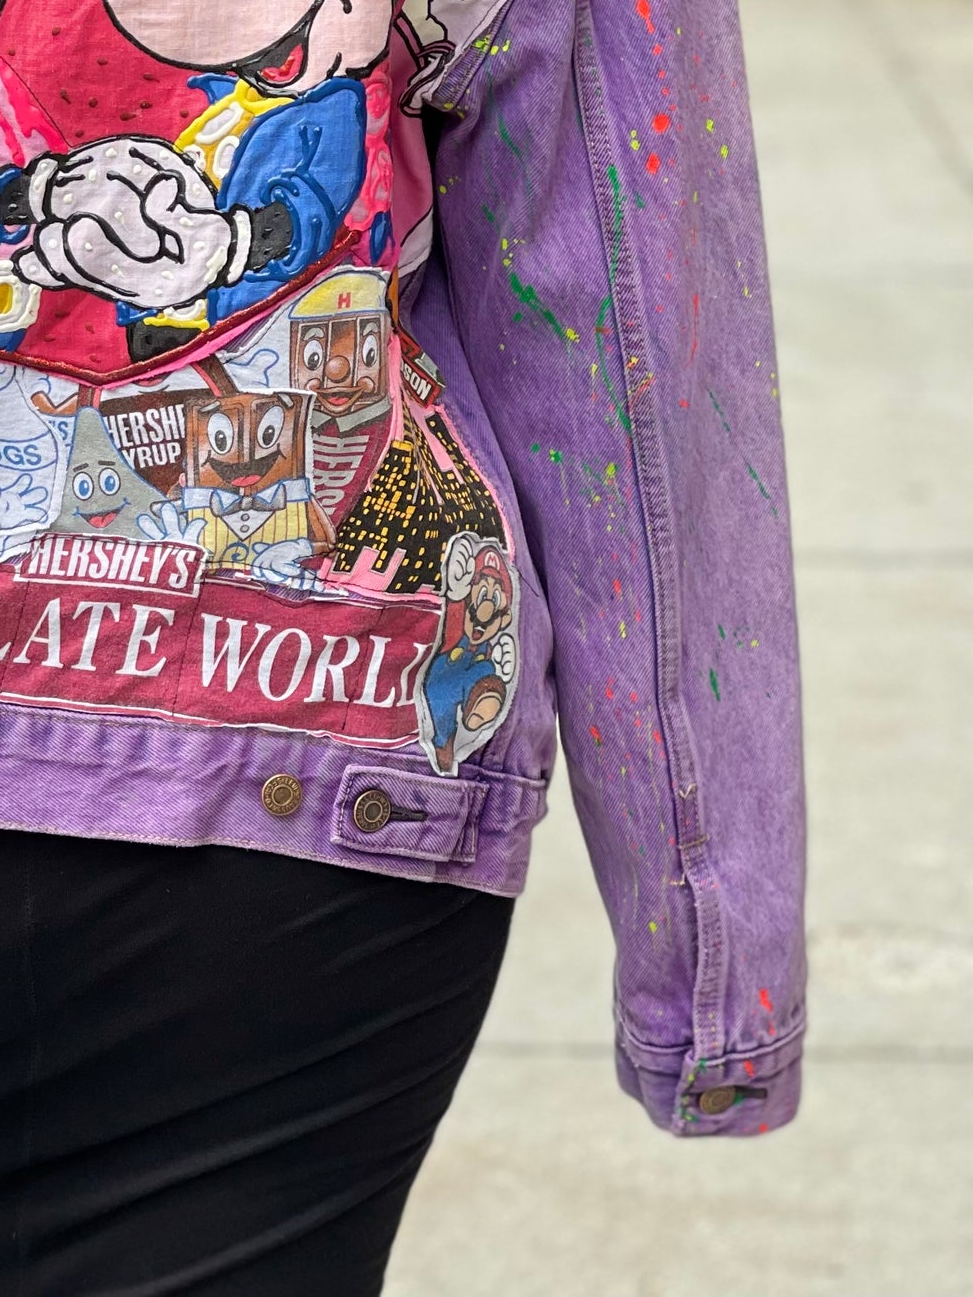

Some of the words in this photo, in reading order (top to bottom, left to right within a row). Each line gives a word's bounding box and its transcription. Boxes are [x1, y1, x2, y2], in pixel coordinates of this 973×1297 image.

[339, 292, 351, 308] H
[401, 358, 432, 401] SON
[28, 540, 196, 589] HERSHEY'S
